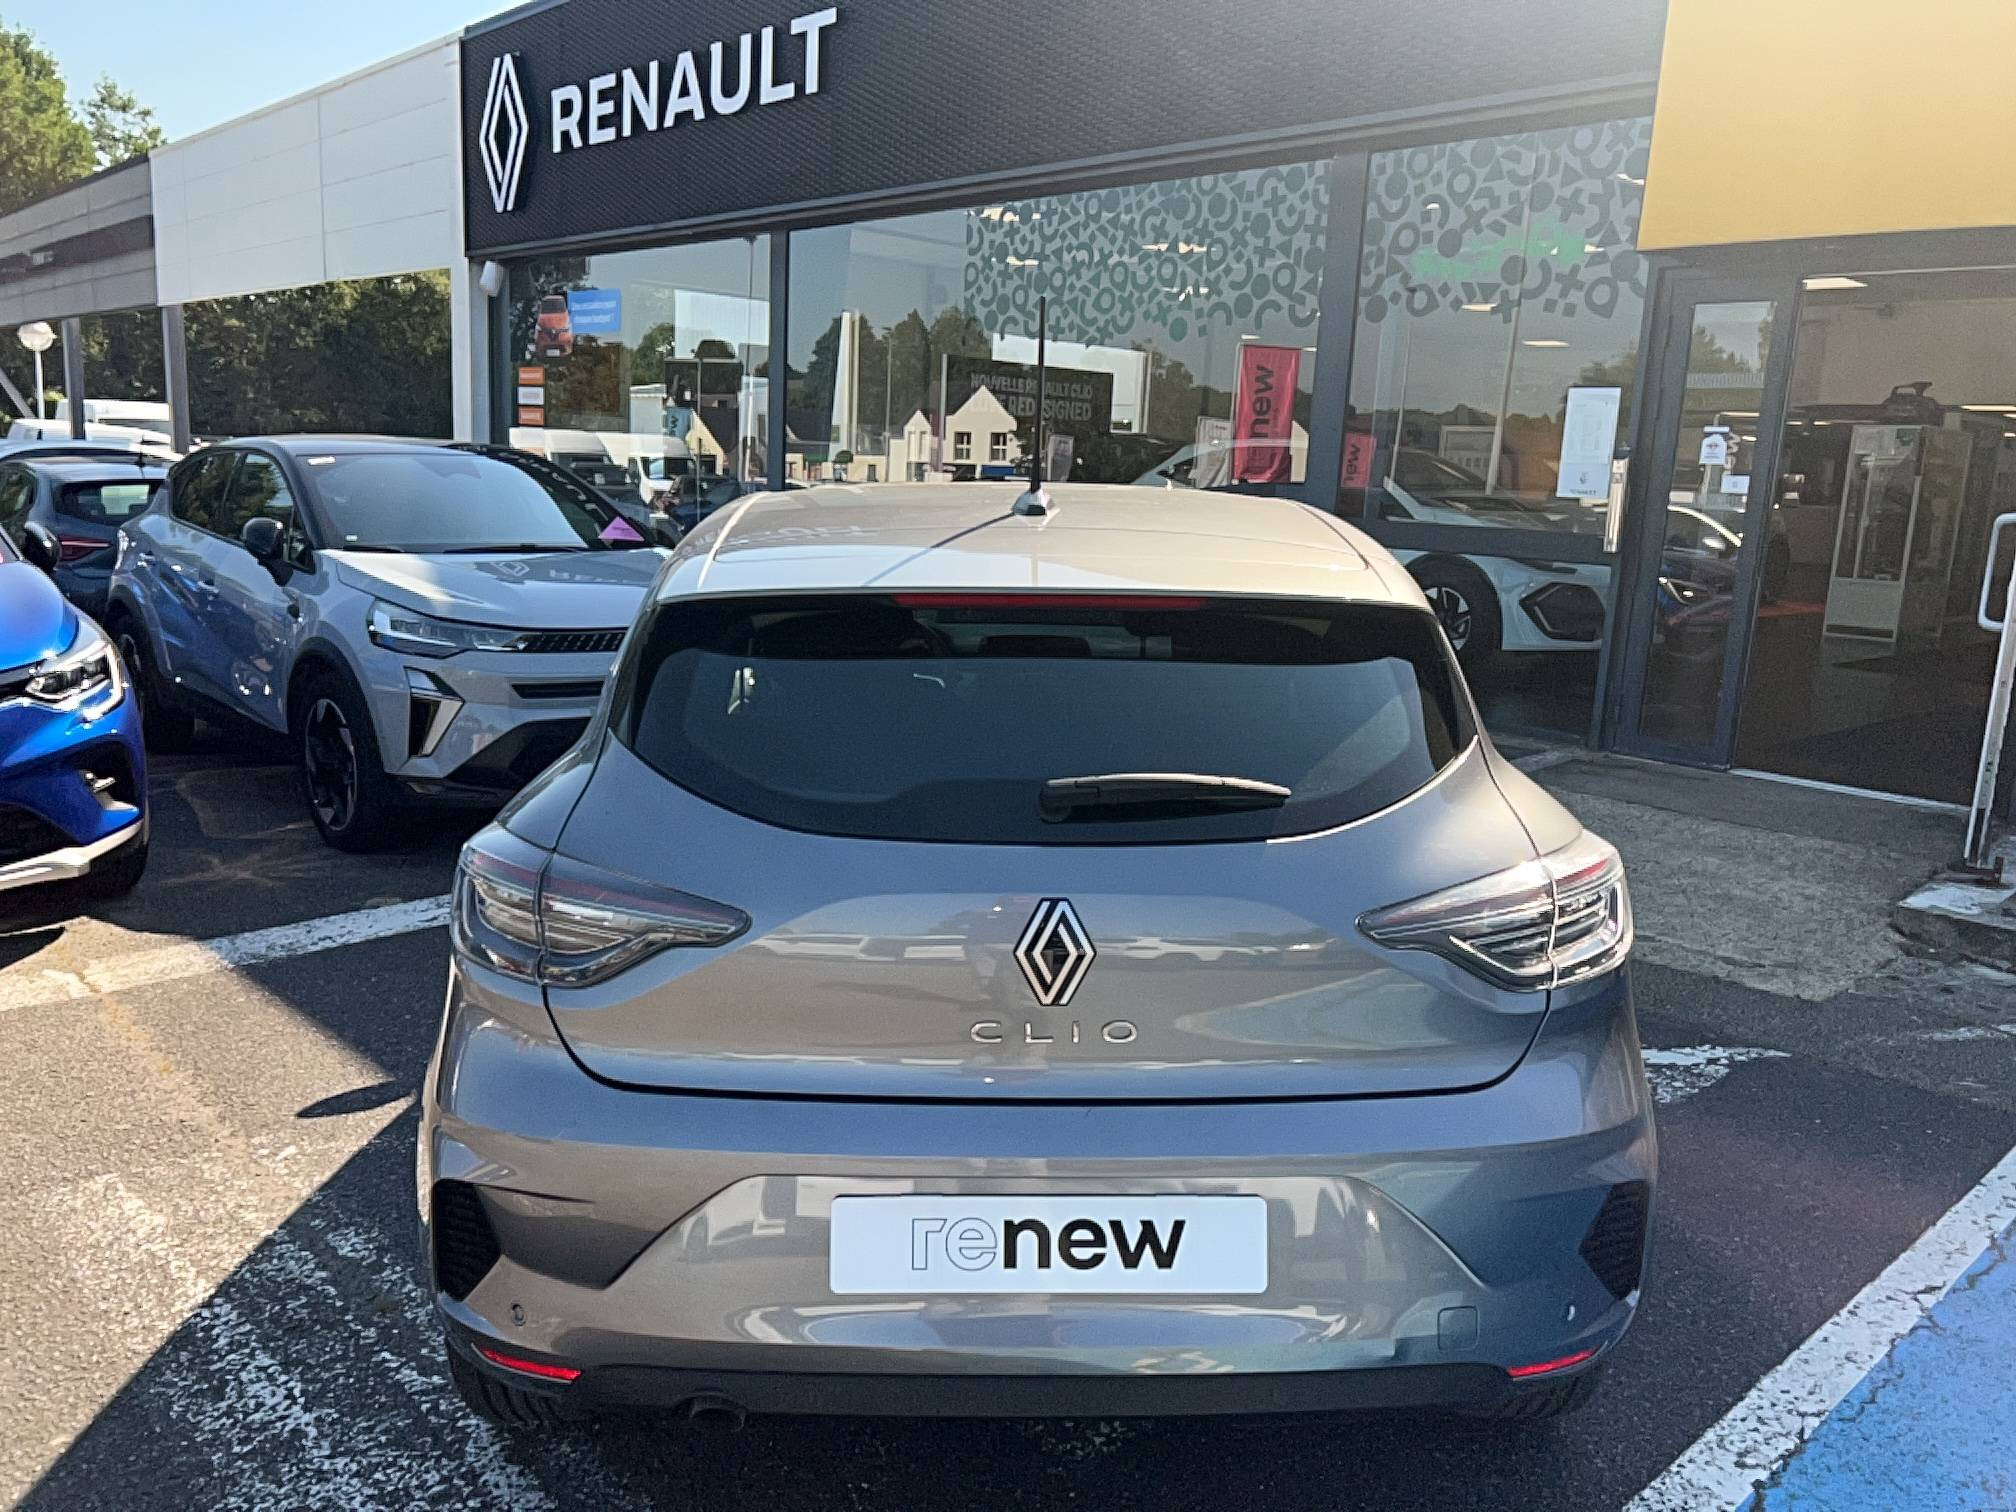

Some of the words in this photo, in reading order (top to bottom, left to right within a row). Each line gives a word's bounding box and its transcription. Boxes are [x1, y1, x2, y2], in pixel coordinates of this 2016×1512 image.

[550, 6, 838, 154] RENAULT
[1008, 394, 1093, 421] REDSIGNED
[970, 1020, 1138, 1043] CLIO
[911, 1216, 1187, 1271] renew
